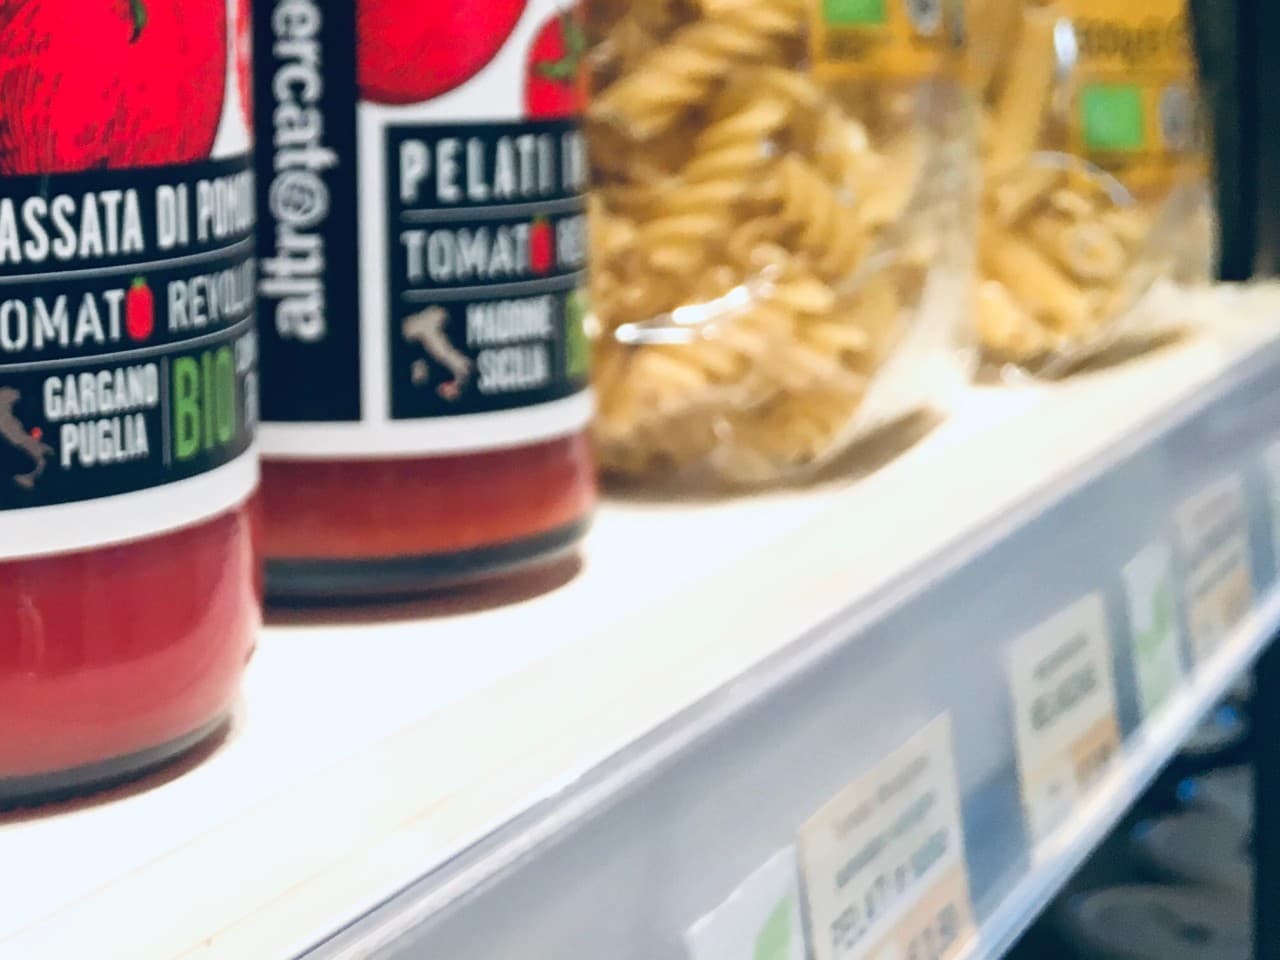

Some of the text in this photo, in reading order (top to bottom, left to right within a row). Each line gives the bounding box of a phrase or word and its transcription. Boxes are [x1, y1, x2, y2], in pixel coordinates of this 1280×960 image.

[400, 134, 554, 205] PELATI
[155, 182, 189, 250] DI
[43, 363, 159, 422] GARGANO
[173, 344, 237, 461] BIO
[59, 415, 150, 468] PUGLIA
